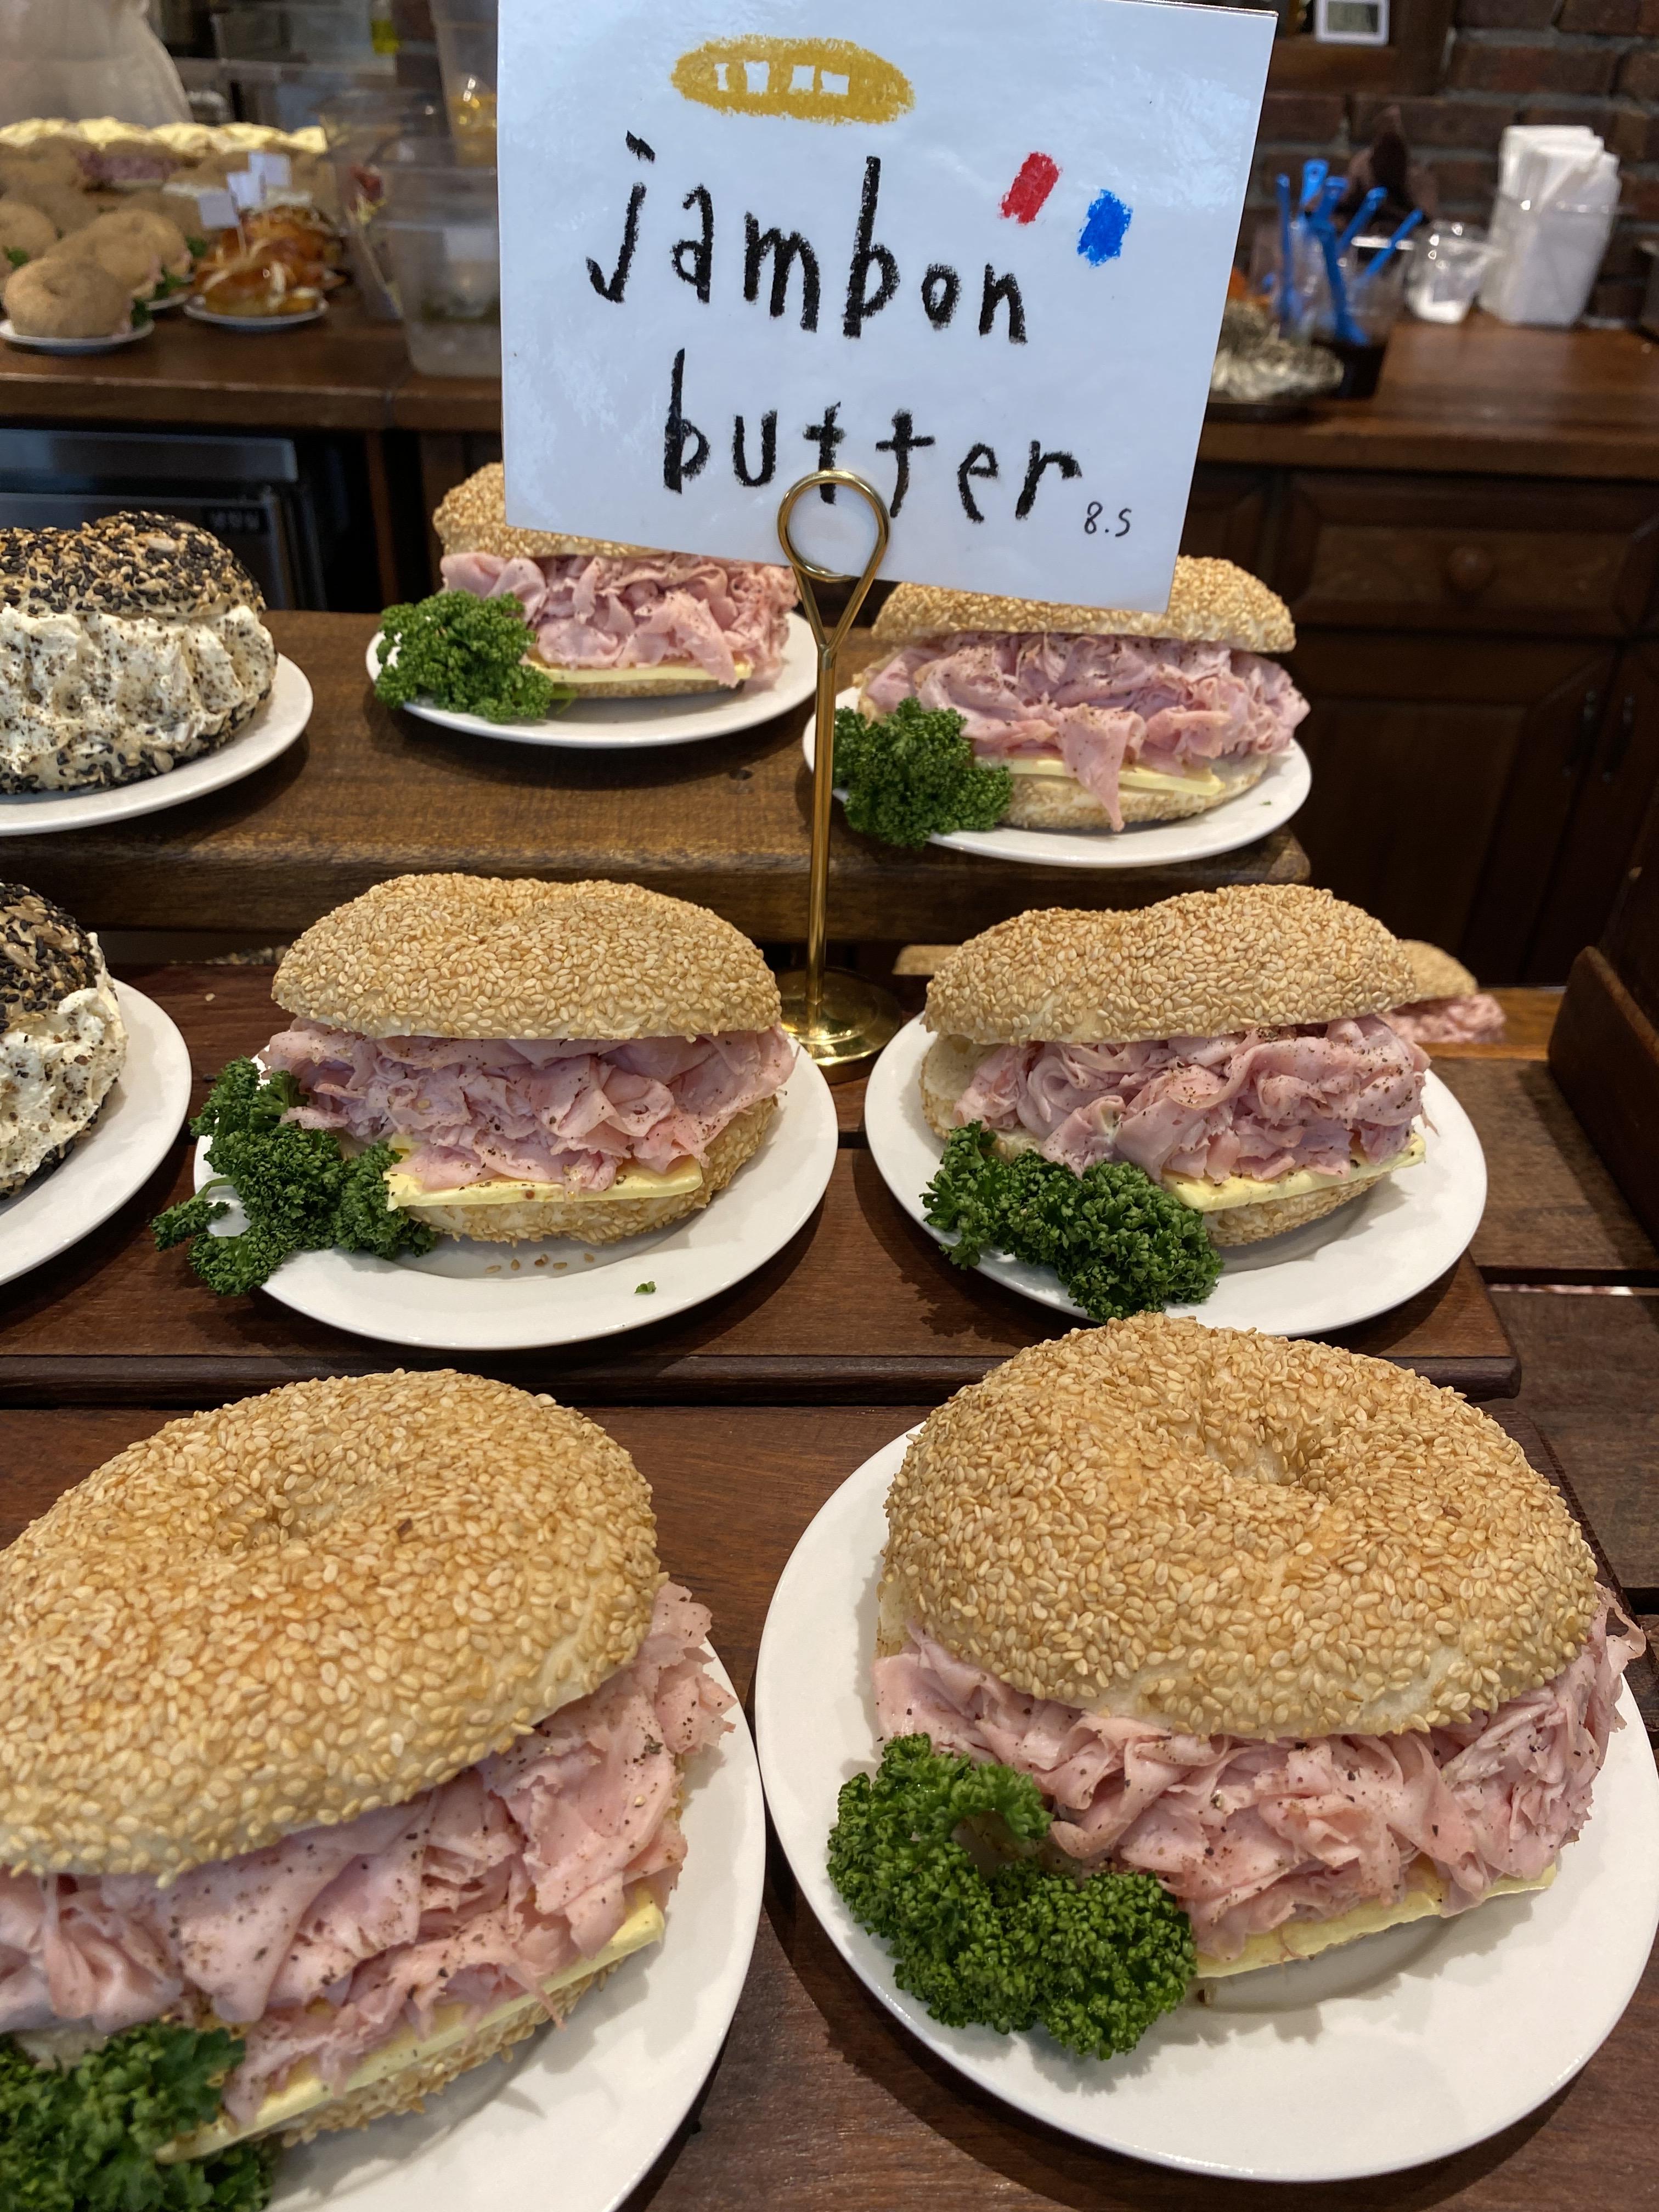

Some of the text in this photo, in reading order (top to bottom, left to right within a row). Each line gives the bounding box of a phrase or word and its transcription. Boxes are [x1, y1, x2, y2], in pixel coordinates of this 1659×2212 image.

[586, 130, 1026, 344] jambon
[664, 348, 1082, 523] butter
[1084, 501, 1132, 537] 8.5
